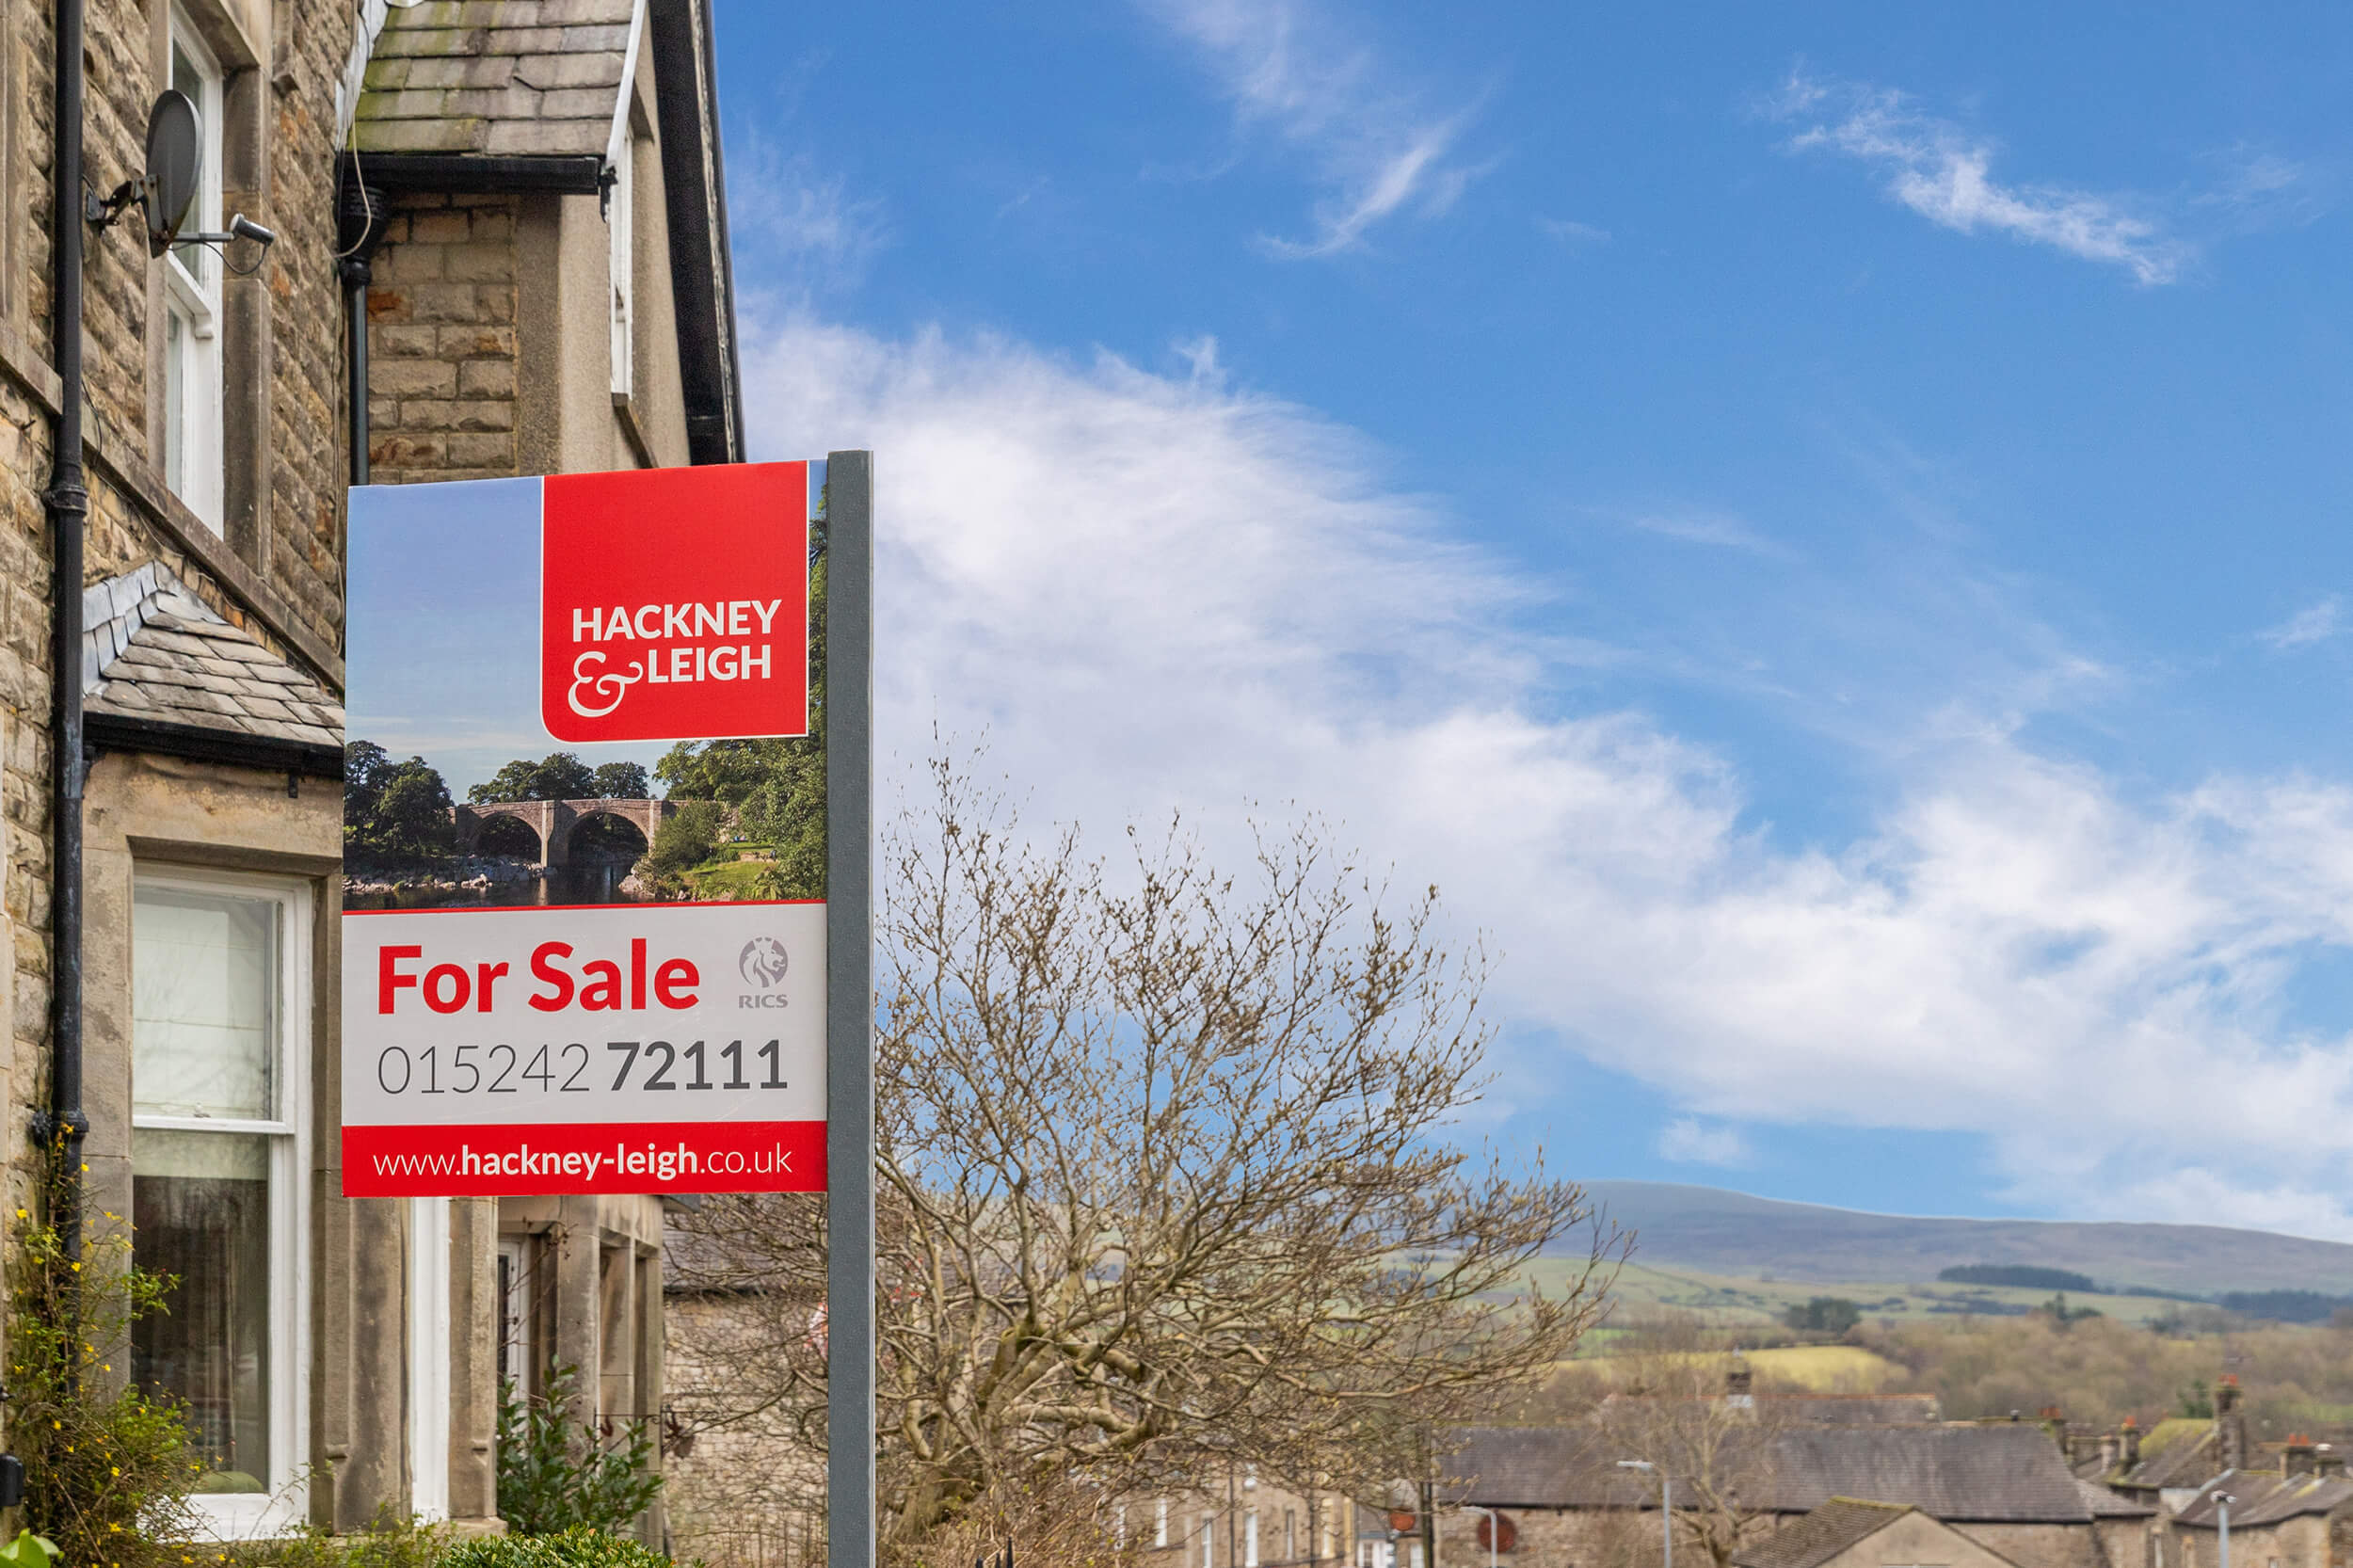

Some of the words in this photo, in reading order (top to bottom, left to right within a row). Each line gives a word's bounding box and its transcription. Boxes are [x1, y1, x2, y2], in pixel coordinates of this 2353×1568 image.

[572, 600, 782, 642] HACKNEY
[378, 945, 509, 1015] For
[528, 937, 699, 1012] Sale
[739, 994, 789, 1009] RICS
[378, 1044, 590, 1095] 015242
[607, 1039, 788, 1091] 72111
[374, 1143, 792, 1180] www.hackney-leigh.co.uk
